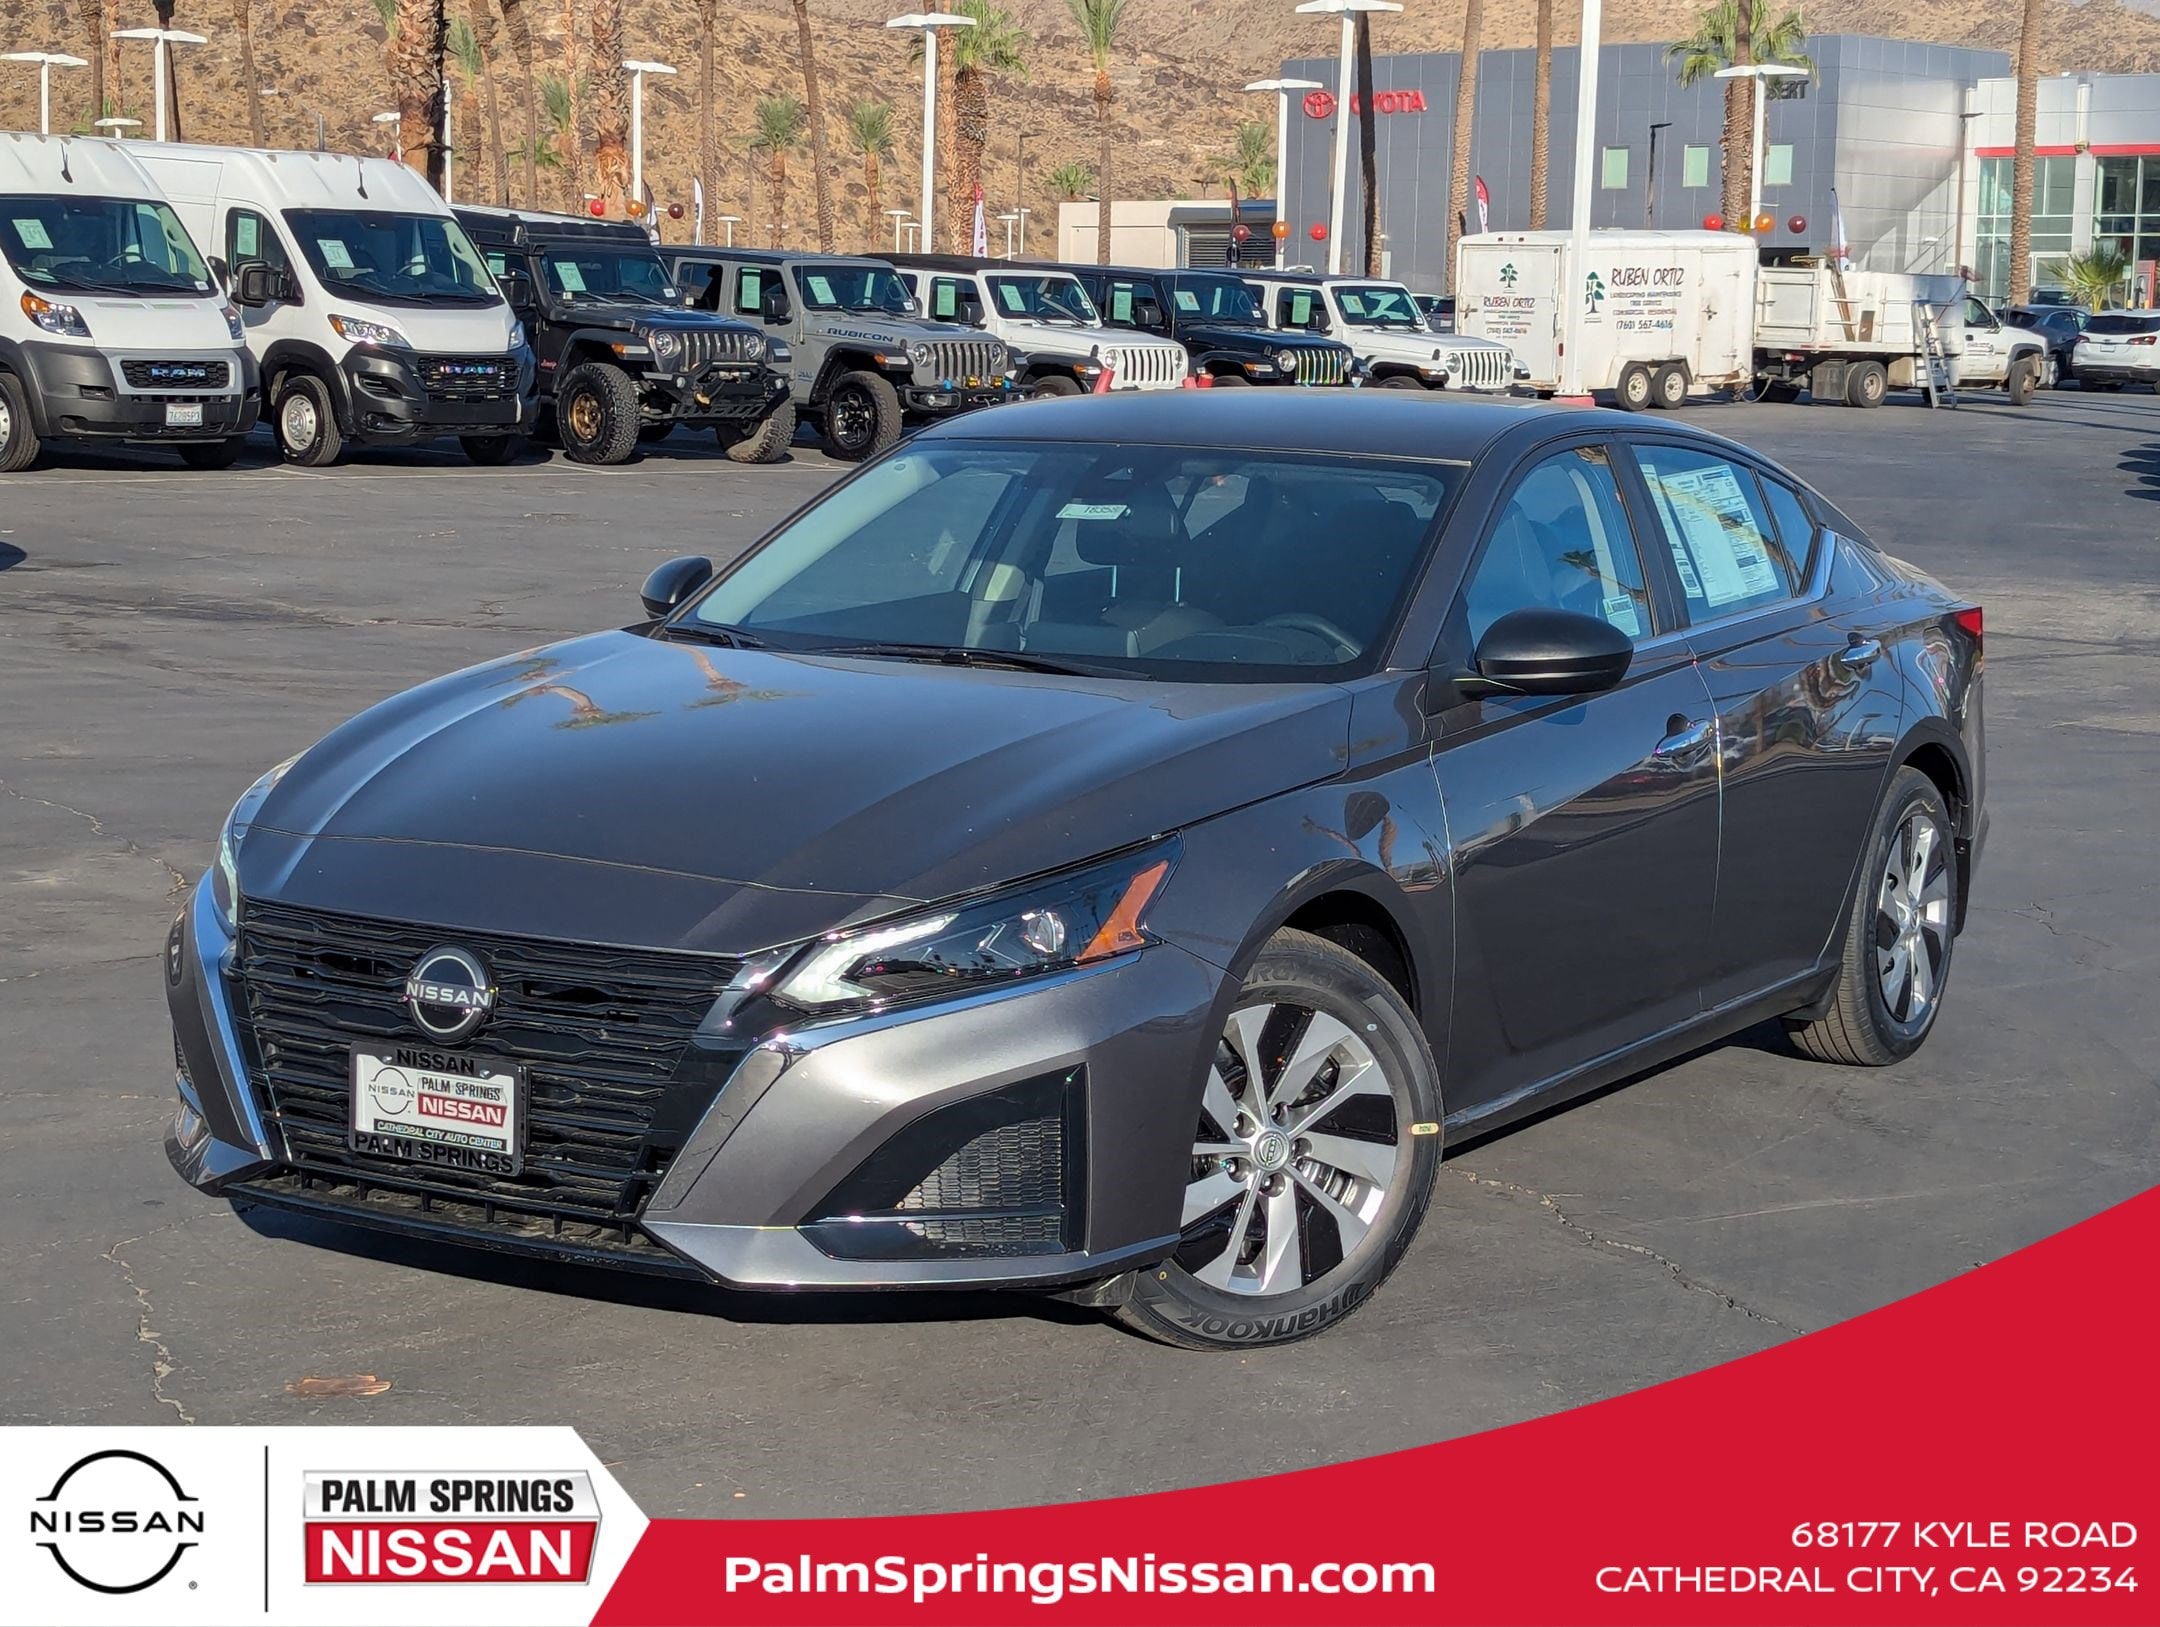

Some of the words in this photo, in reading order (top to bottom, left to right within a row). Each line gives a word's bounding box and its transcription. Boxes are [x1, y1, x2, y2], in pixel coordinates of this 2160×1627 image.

[1611, 267, 1650, 287] RUBEN
[1653, 267, 1684, 287] ORTIZ
[1483, 297, 1510, 308] RUBEN
[827, 327, 894, 343] RUBICON
[151, 368, 206, 378] RAM
[406, 982, 491, 1006] NISSAN
[397, 1049, 474, 1075] NISSAN
[368, 1084, 415, 1098] NISSAN
[421, 1077, 451, 1093] PALM
[455, 1082, 500, 1101] SPRINGS
[422, 1097, 501, 1124] NISSAN
[377, 1121, 425, 1137] CATHEDRAL
[425, 1129, 443, 1140] CITY
[444, 1132, 468, 1144] AUTO
[468, 1136, 503, 1150] CENTER
[354, 1135, 412, 1157] PALM
[419, 1142, 513, 1173] SPRINGS
